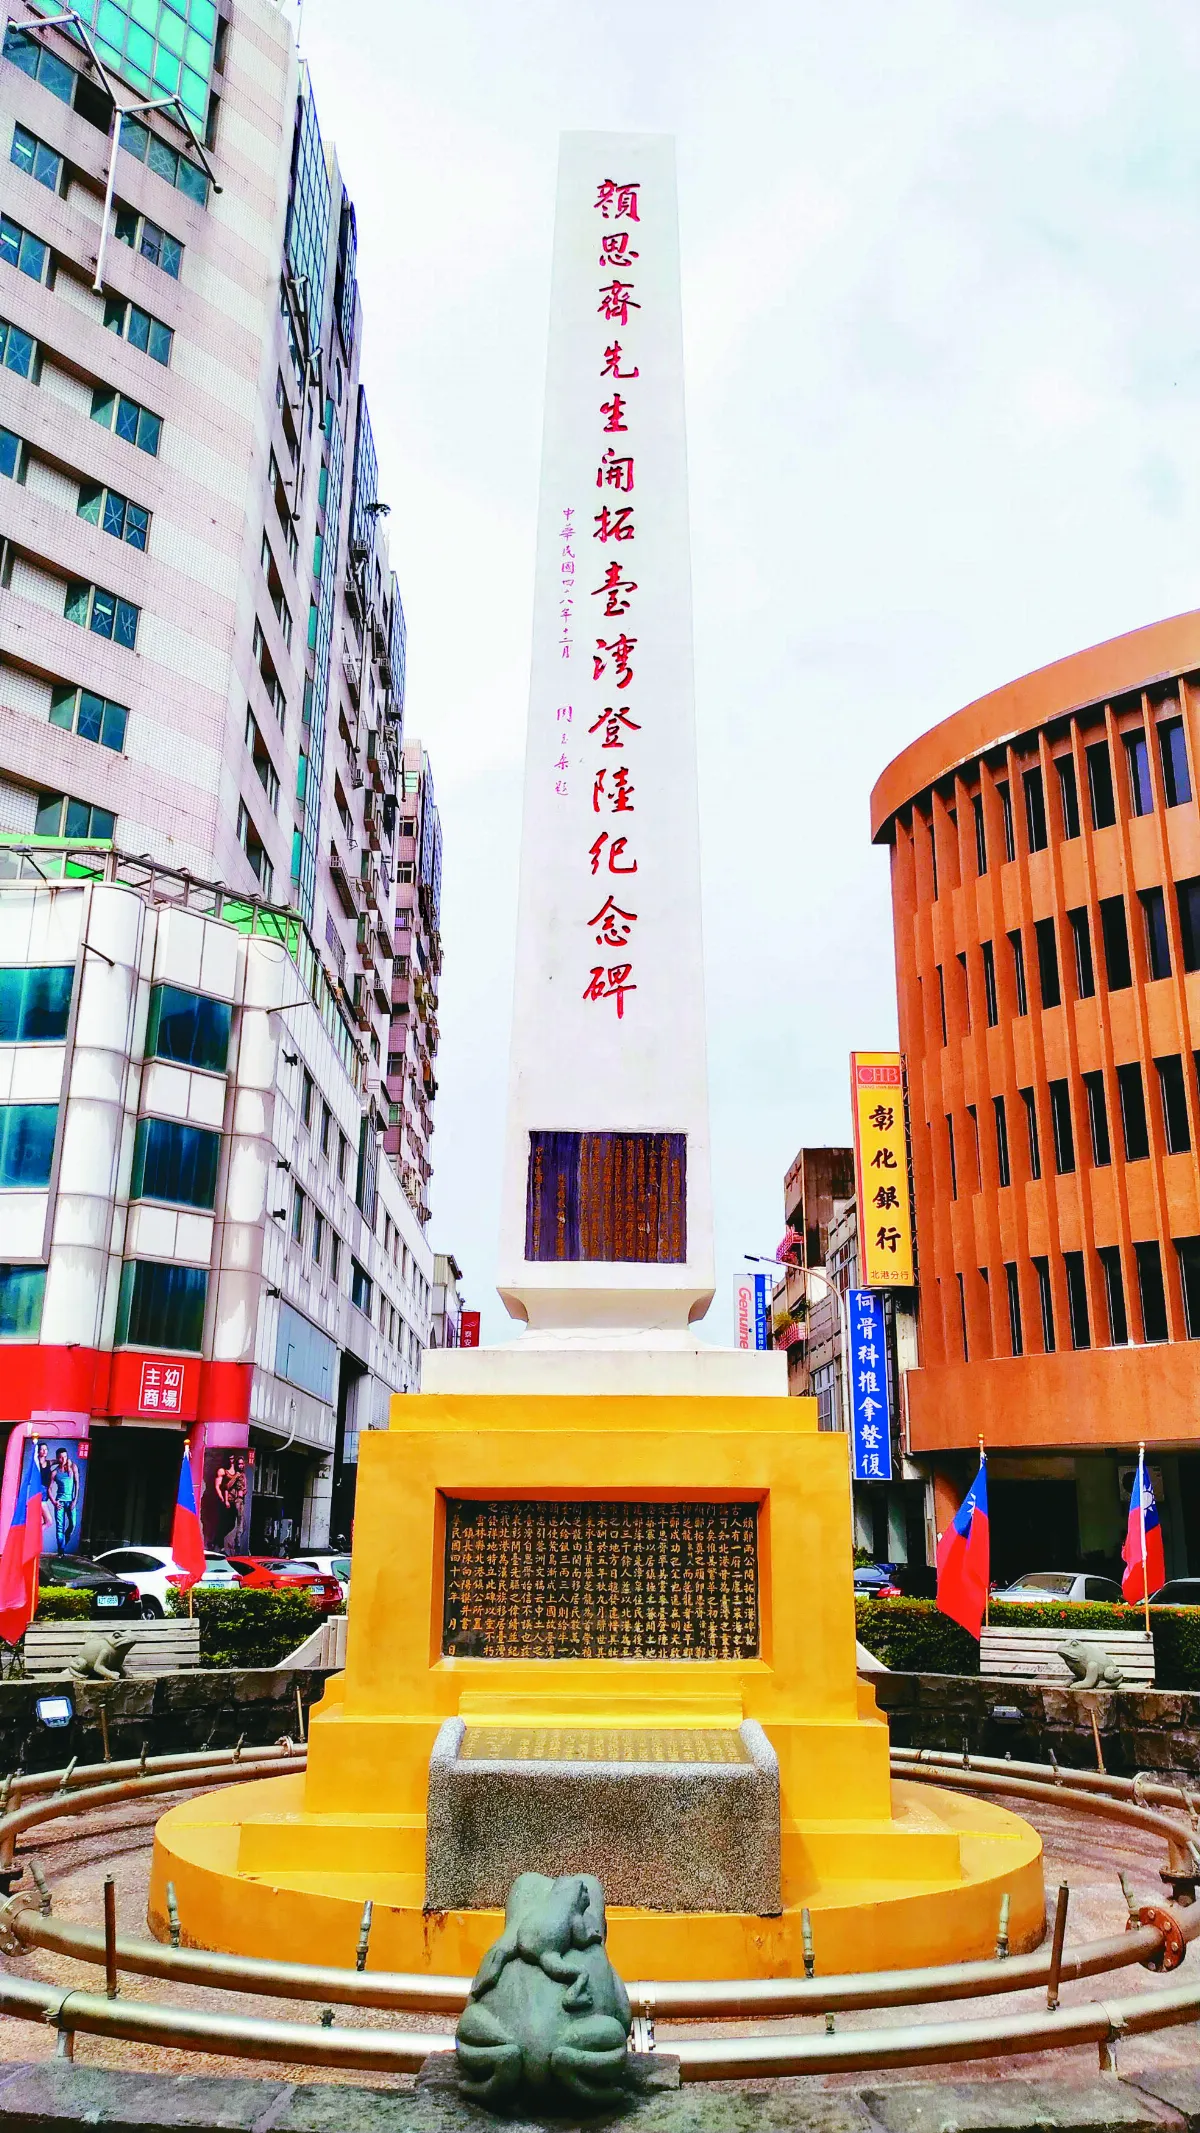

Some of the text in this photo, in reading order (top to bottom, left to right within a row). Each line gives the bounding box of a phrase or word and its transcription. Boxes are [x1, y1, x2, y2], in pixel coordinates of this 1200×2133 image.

[858, 1067, 899, 1083] CHB
[869, 1105, 901, 1253] 彰化銀行
[870, 1270, 909, 1280] 北港分行
[739, 1286, 752, 1350] Genuine
[145, 1367, 180, 1387] 主幼
[855, 1292, 885, 1477] 何骨科推拿整復
[143, 1389, 178, 1408] 商場
